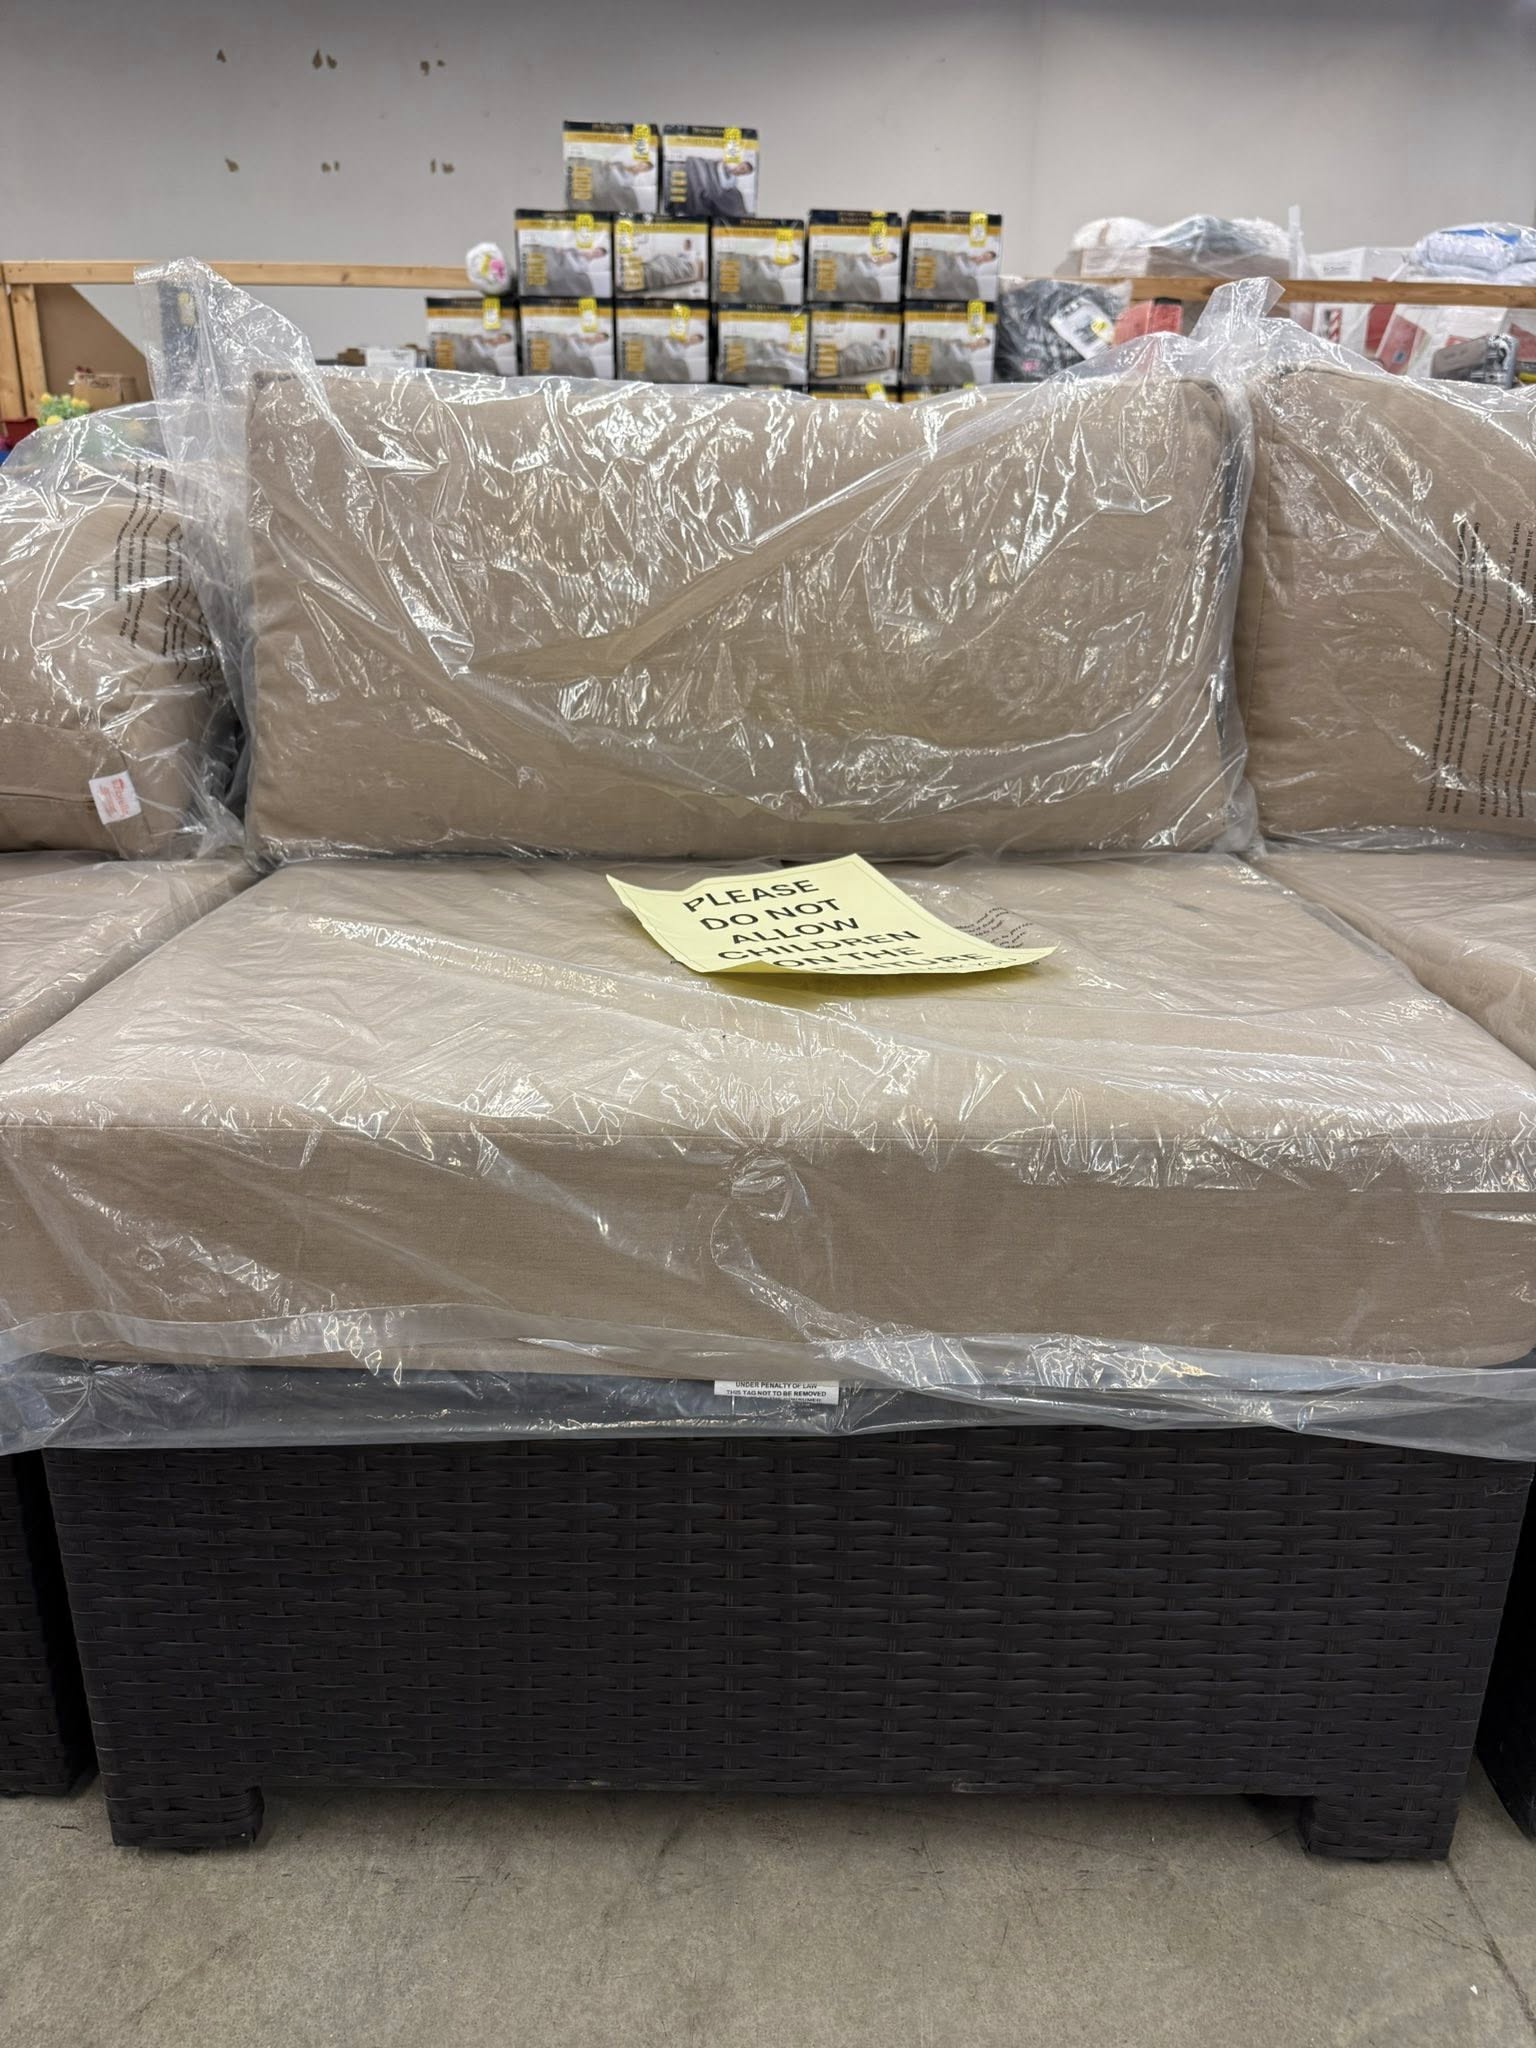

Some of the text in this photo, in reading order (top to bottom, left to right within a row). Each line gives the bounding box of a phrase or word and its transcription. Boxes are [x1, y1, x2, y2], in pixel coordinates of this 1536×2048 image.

[683, 880, 819, 912] PLEASE
[700, 898, 840, 930] DO NOT
[718, 931, 921, 960] CHILDREN
[732, 918, 859, 944] ALLOW
[772, 947, 924, 967] ON THE
